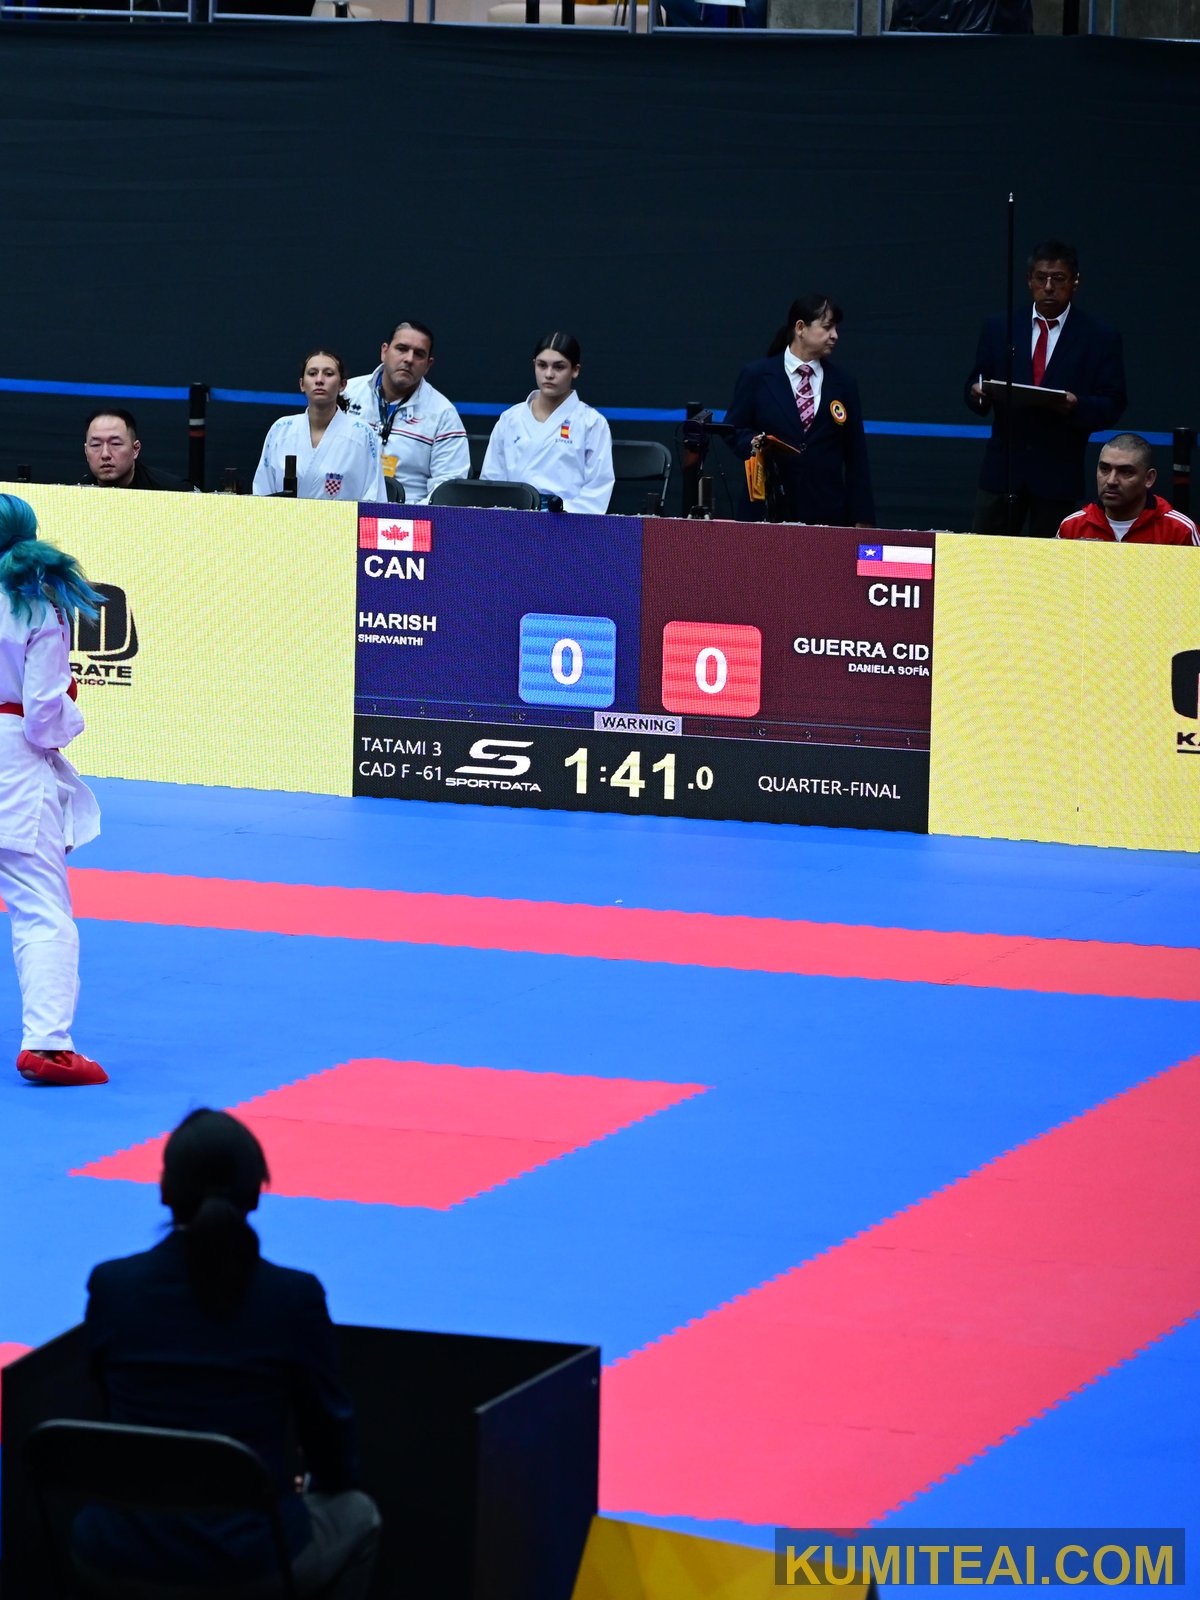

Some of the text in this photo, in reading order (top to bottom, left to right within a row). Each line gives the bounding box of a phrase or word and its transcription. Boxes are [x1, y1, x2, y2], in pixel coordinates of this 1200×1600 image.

[364, 554, 425, 580] CAN
[868, 583, 920, 608] CHI
[359, 611, 437, 632] HARISH
[358, 633, 424, 646] SHRAVANTHI
[793, 637, 930, 661] GUERRA CID
[69, 662, 132, 679] RATE
[550, 638, 584, 686] 0
[694, 647, 728, 694] 0
[848, 663, 930, 676] DANIELA SOFÍA
[76, 677, 106, 686] XICO
[601, 716, 676, 732] WARNING
[361, 737, 442, 757] TATAMI 3
[359, 761, 442, 781] CAD F -61
[445, 777, 542, 793] SPORTDATA
[758, 775, 901, 800] QUARTER-FINAL
